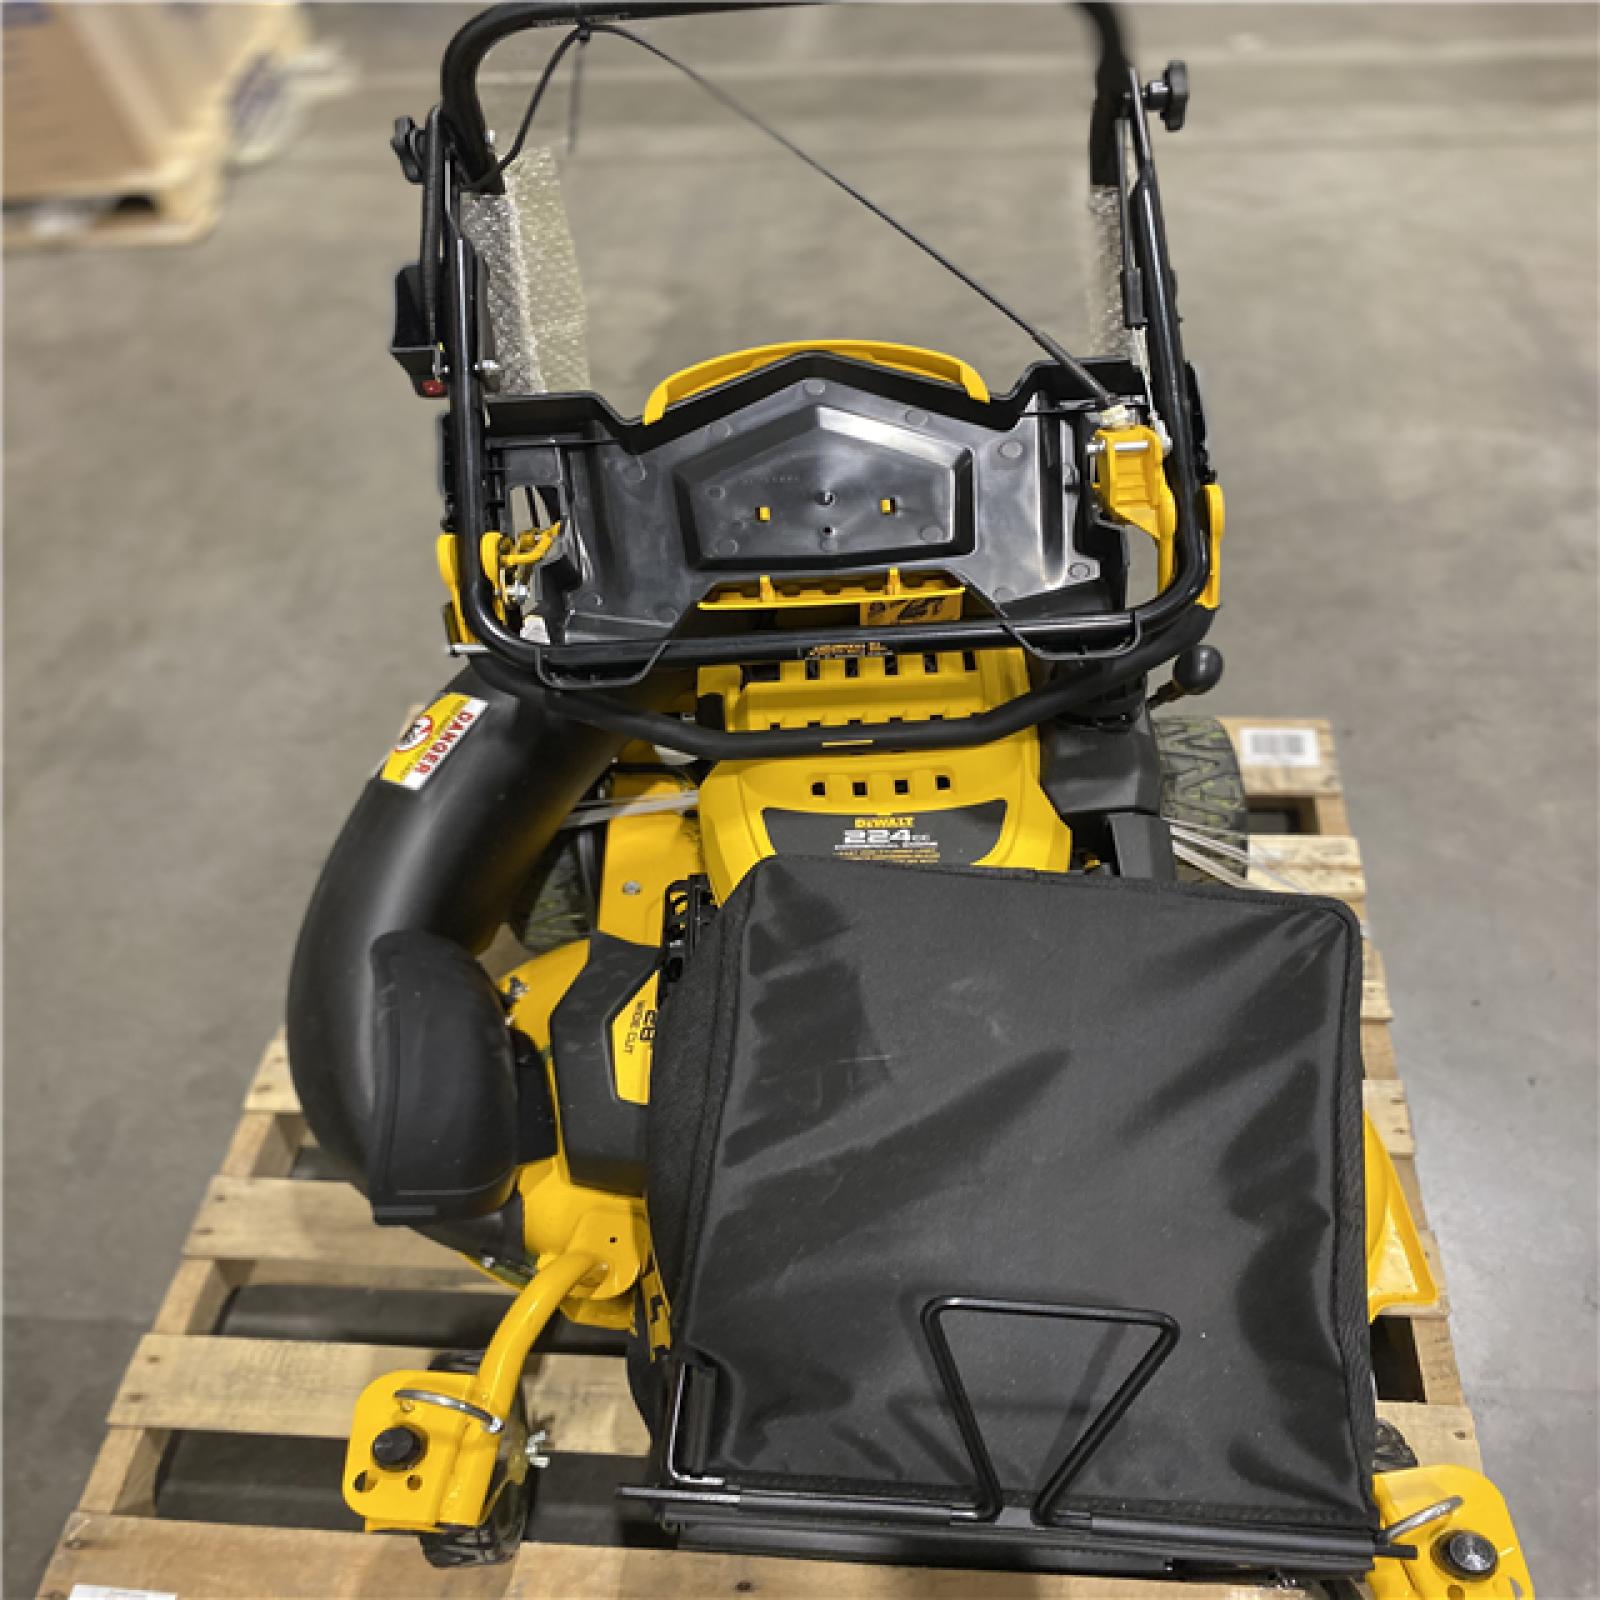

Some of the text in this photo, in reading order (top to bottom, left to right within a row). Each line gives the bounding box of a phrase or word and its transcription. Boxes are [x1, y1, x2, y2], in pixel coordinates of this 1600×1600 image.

[415, 712, 473, 773] DANGER
[844, 829, 911, 844] 224
[623, 1032, 638, 1053] CUT
